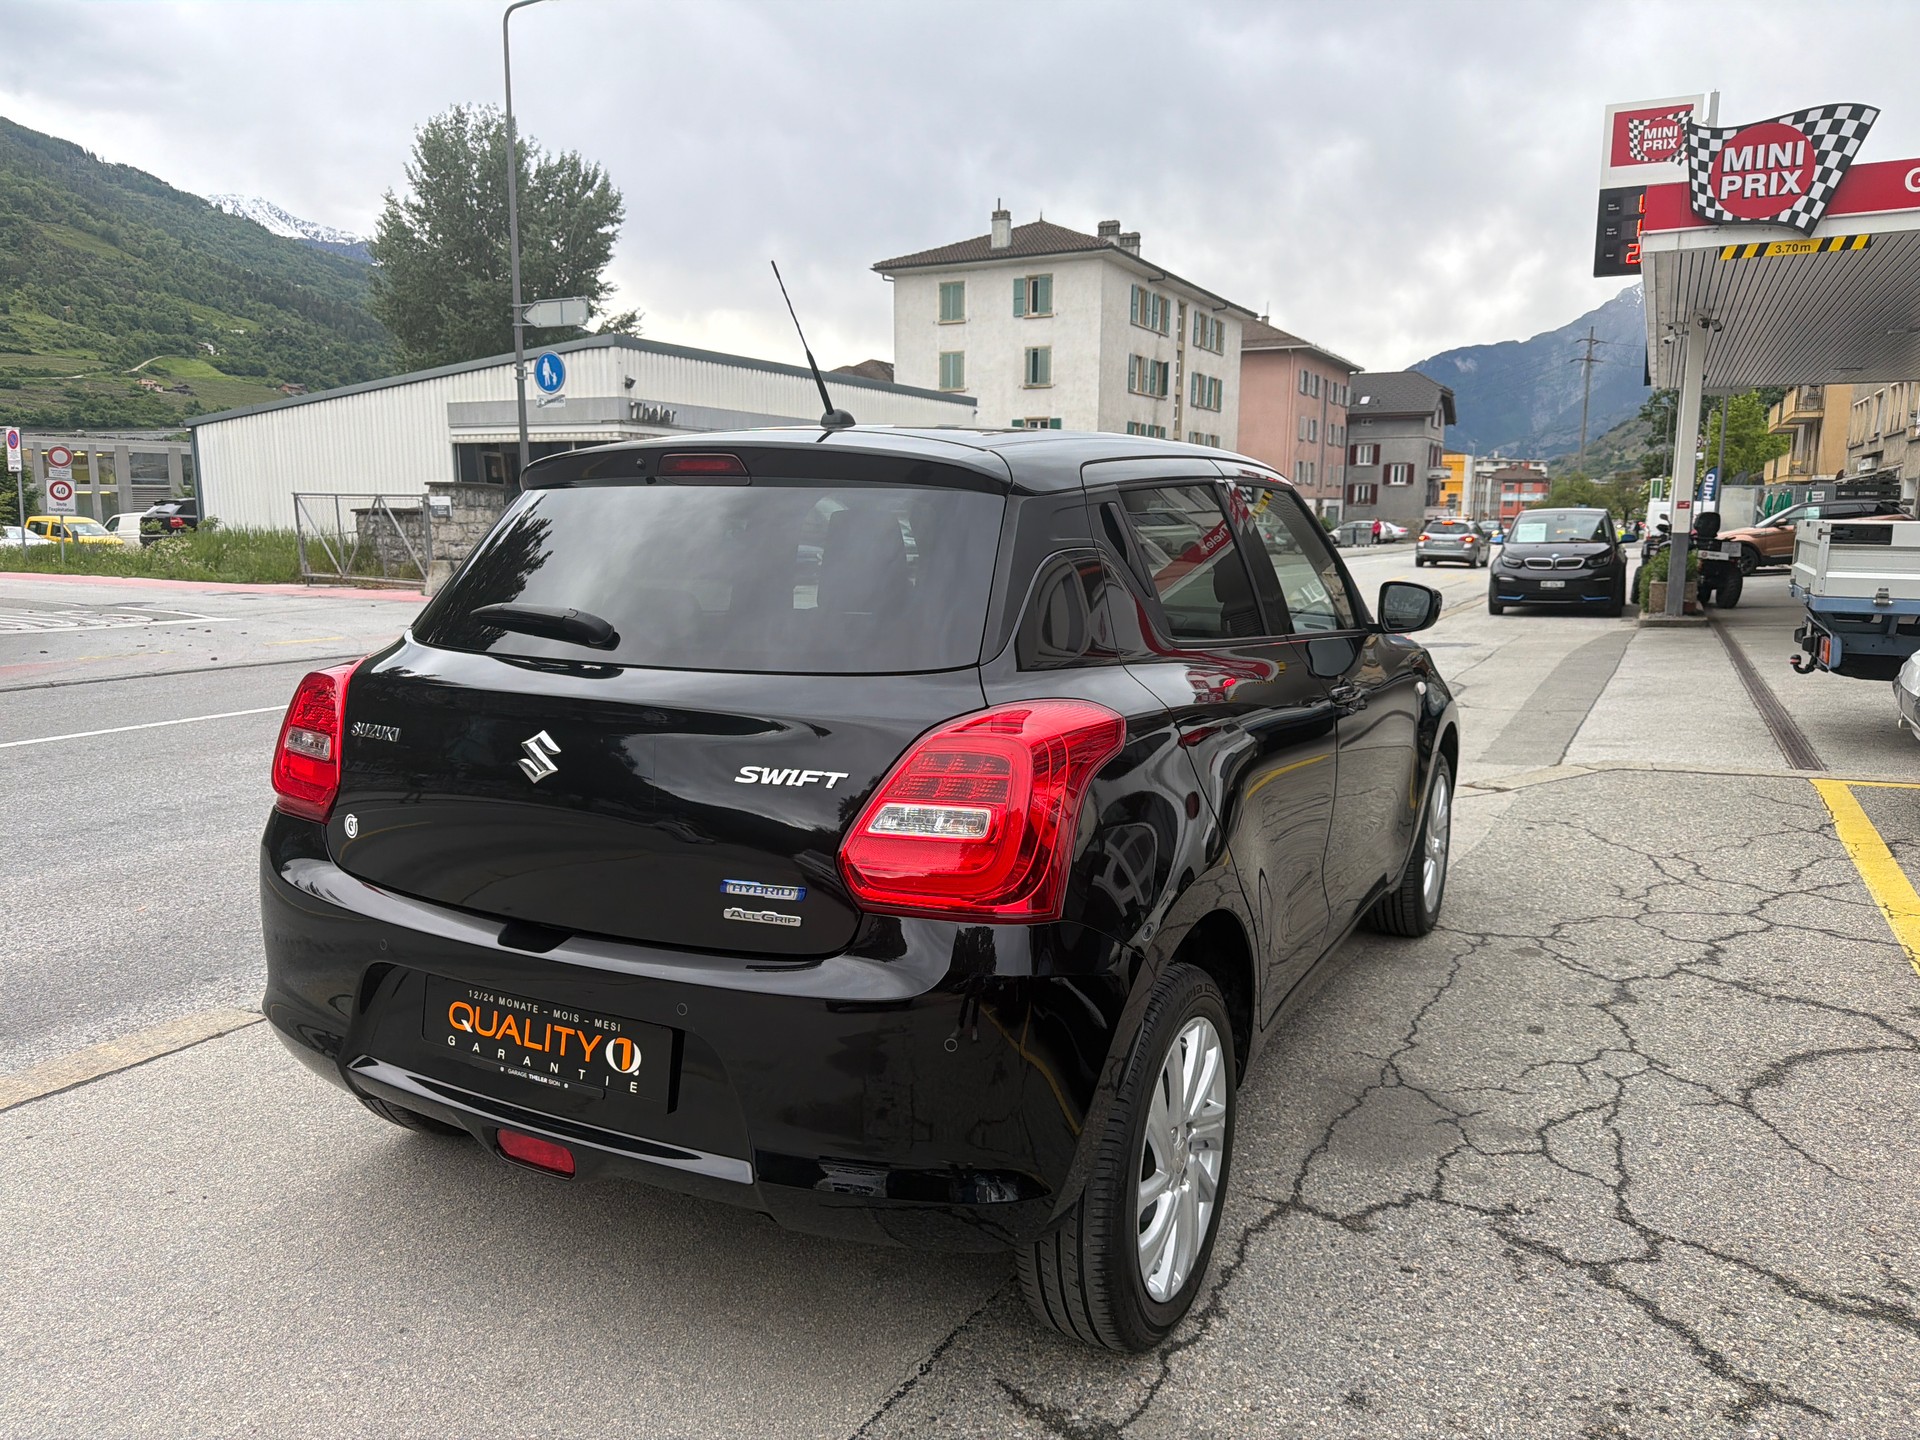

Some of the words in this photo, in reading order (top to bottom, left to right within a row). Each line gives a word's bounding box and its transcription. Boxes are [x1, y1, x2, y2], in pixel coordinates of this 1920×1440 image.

[1643, 125, 1678, 139] MINI
[1642, 138, 1678, 151] PRIX
[1721, 140, 1806, 174] MINI
[1719, 170, 1804, 201] PRIX
[56, 487, 66, 495] 40
[350, 721, 401, 742] SUZUKI
[734, 765, 849, 789] SWIFT
[731, 883, 793, 897] HYBRID
[468, 989, 495, 1003] 12/24
[498, 996, 539, 1015] MONATE
[553, 1009, 580, 1024] MOIS
[595, 1018, 622, 1033] MESI
[448, 1000, 603, 1063] QUALITY
[447, 1035, 638, 1094] GARANTIE
[507, 1067, 528, 1079] GARAGE
[528, 1073, 548, 1084] THELER
[549, 1077, 561, 1088] SION
